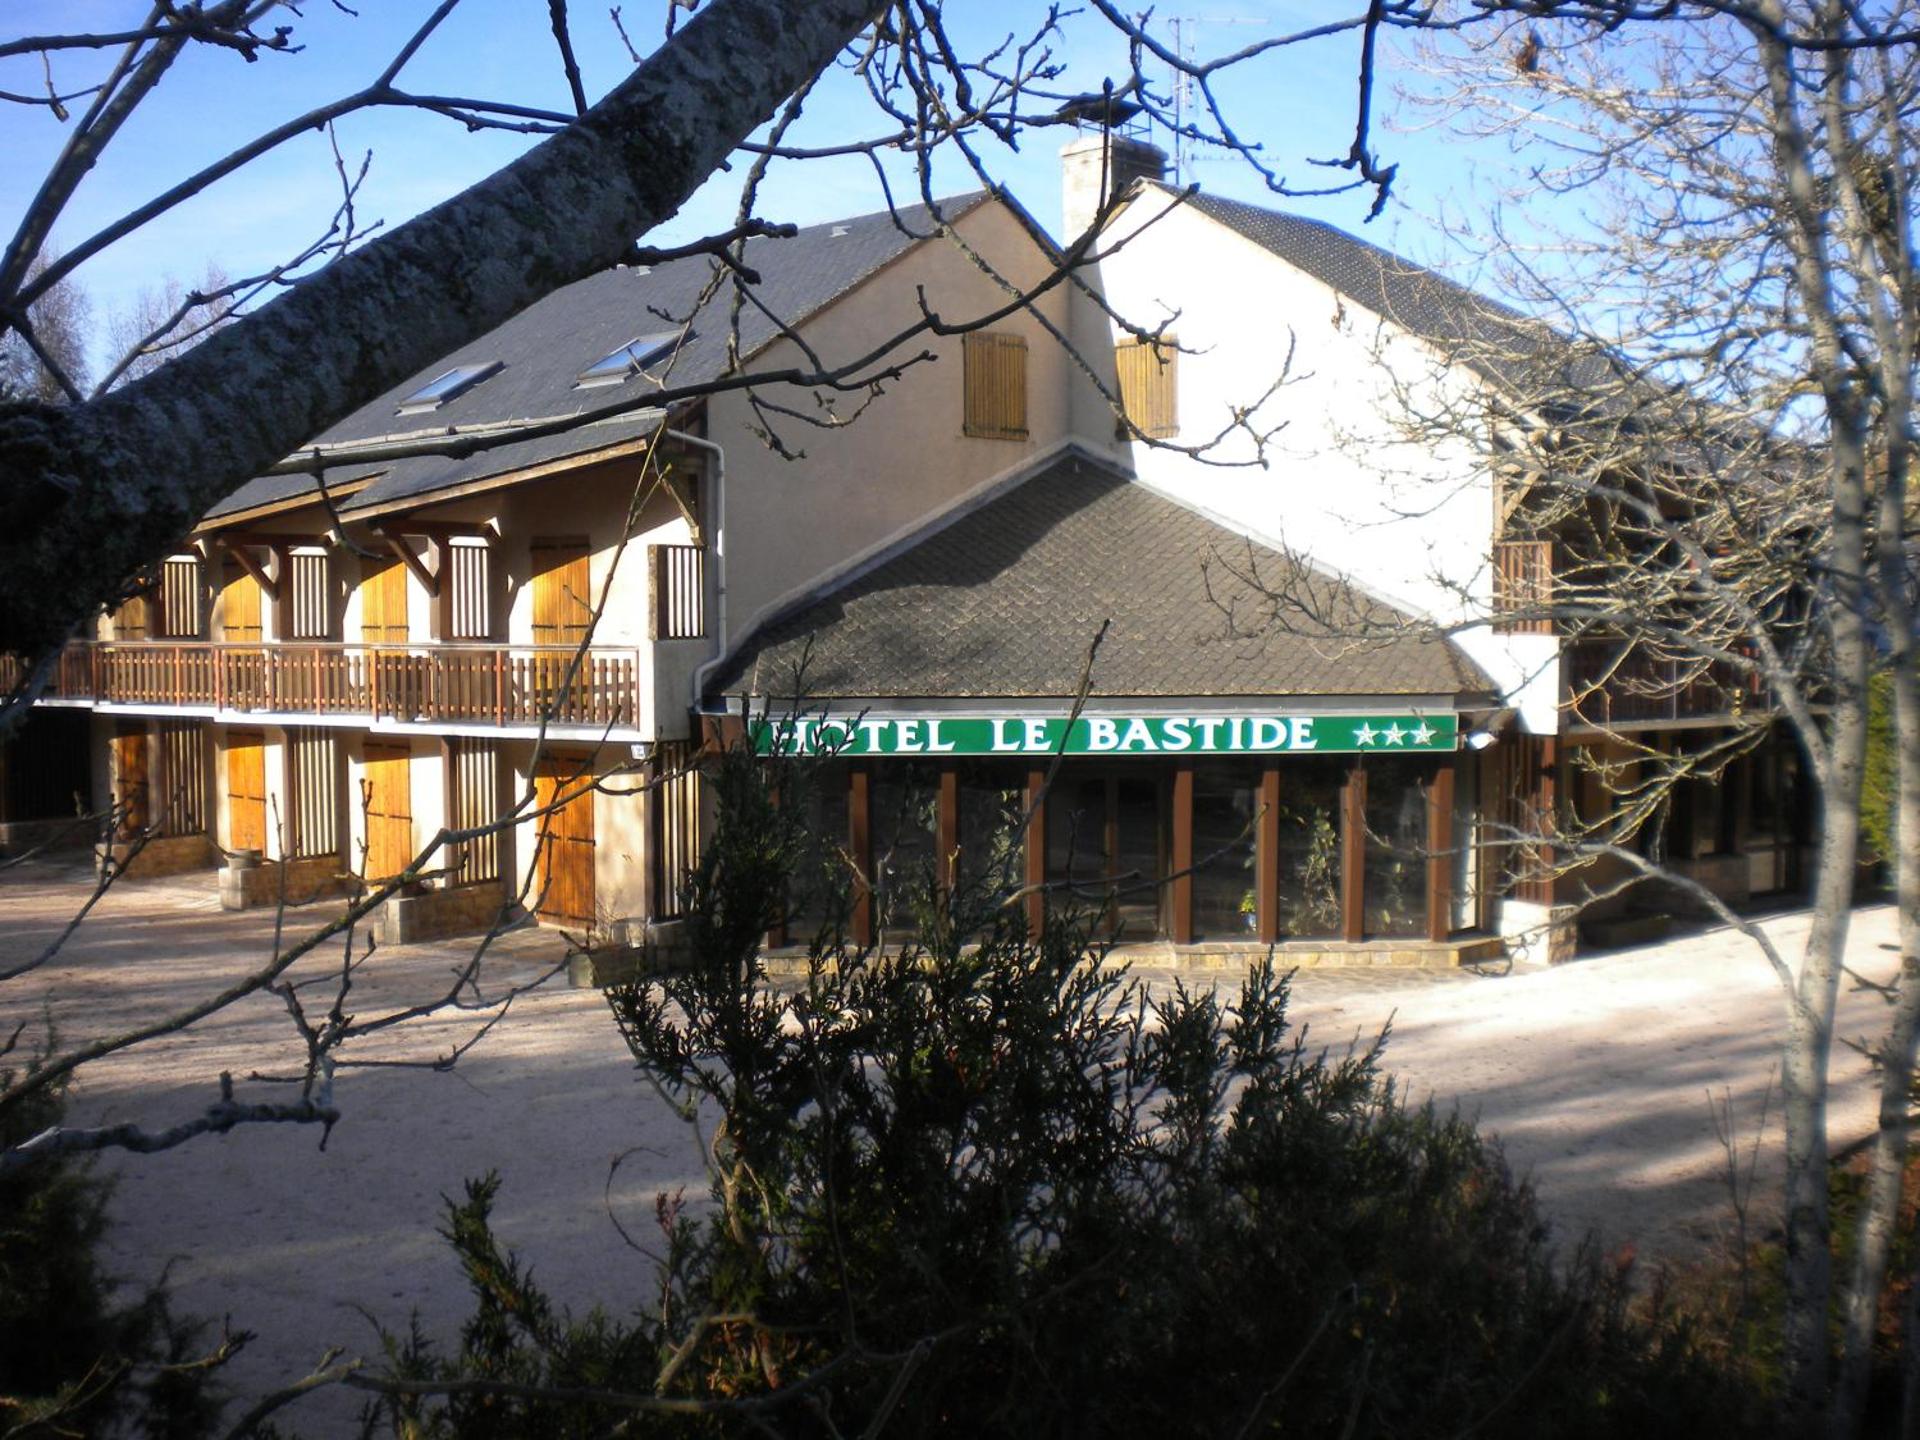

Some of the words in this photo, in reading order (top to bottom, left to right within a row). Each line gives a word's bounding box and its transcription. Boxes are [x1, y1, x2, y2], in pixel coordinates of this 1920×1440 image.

[771, 719, 955, 753] HOTEL
[991, 719, 1053, 752] LE
[1088, 717, 1319, 752] BASTIDE
